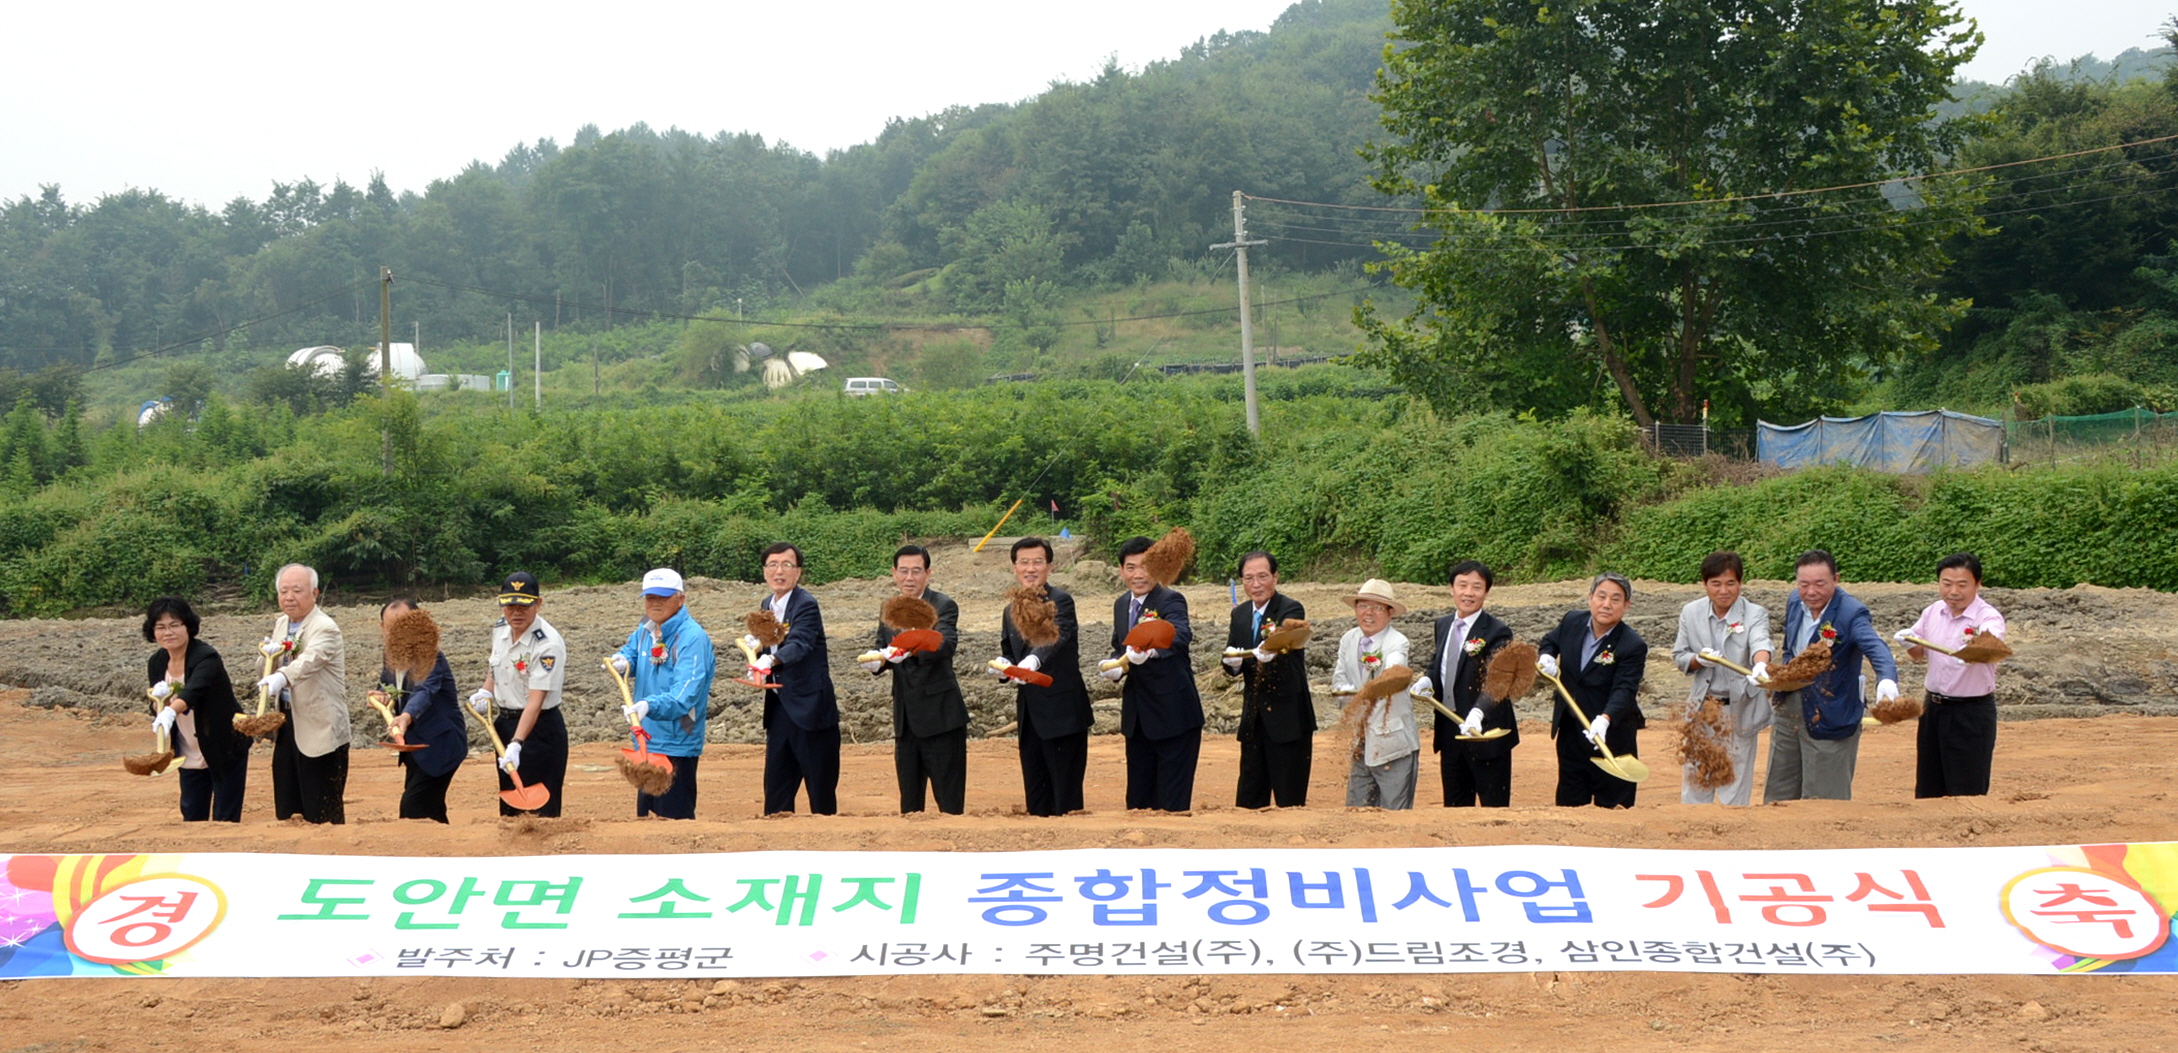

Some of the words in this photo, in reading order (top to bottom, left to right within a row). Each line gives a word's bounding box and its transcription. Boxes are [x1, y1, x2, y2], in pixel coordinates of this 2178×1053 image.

[97, 890, 199, 947] 경
[276, 876, 584, 931] 도안면
[617, 872, 922, 927] 소재지
[967, 867, 1594, 927] 종합정비사업
[1635, 869, 1946, 929] 기공식
[2030, 882, 2138, 940] 축
[396, 947, 516, 970] 발주처
[563, 947, 734, 971] JP증평군
[850, 942, 973, 967] 시공사
[1025, 938, 1274, 967] 주명건설(주),
[1293, 939, 1543, 967] (주)드림조경,
[1559, 940, 1876, 968] 삼인종합건설(주)
